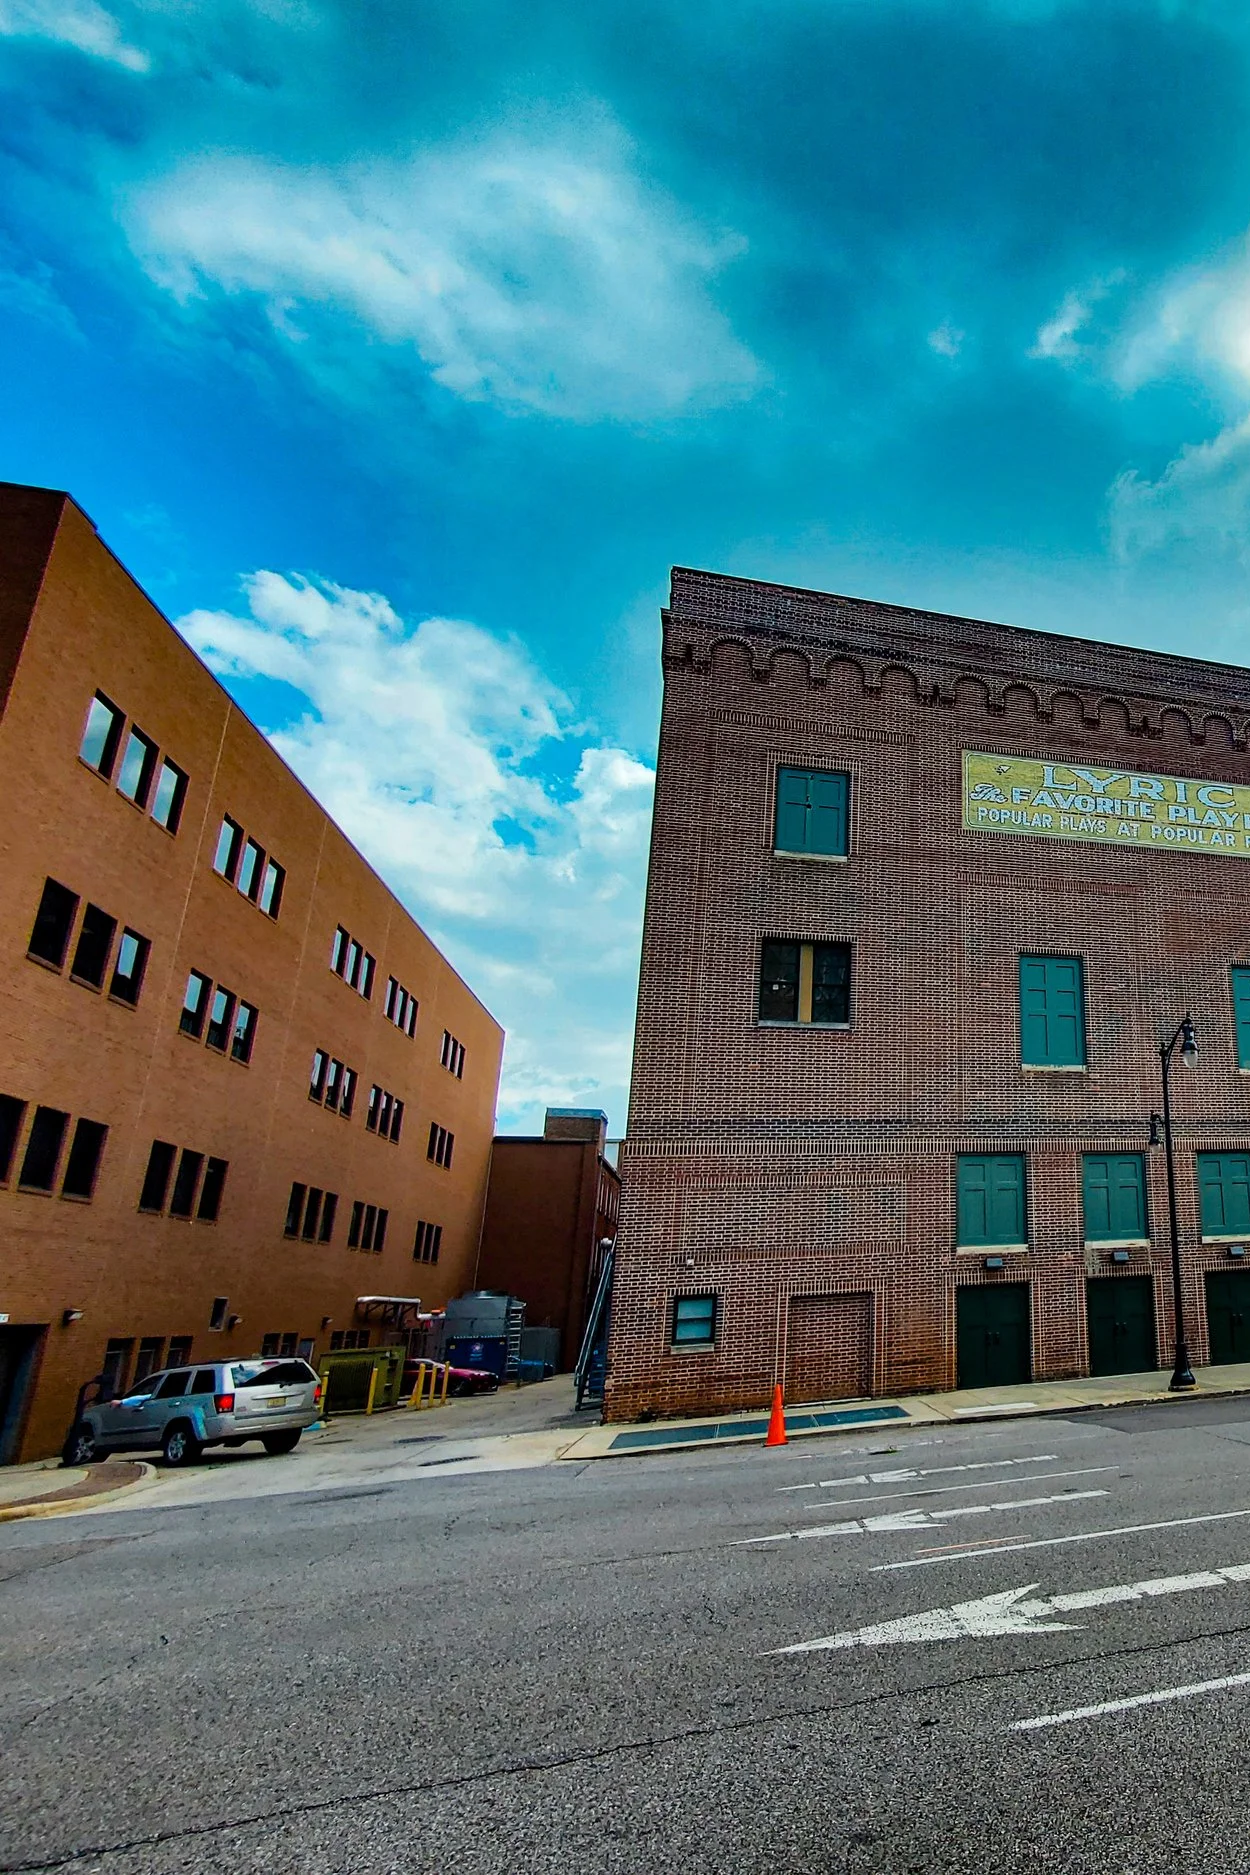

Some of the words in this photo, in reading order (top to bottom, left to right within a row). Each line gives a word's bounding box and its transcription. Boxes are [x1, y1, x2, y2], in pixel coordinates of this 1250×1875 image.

[969, 783, 1008, 803] The
[1011, 787, 1156, 819] FAVORITE
[1042, 765, 1236, 808] LYRIC
[977, 807, 1052, 828] POPULAR
[1060, 815, 1107, 834] PLAYS
[1117, 821, 1141, 837] AT
[1151, 824, 1236, 847] POPULAR
